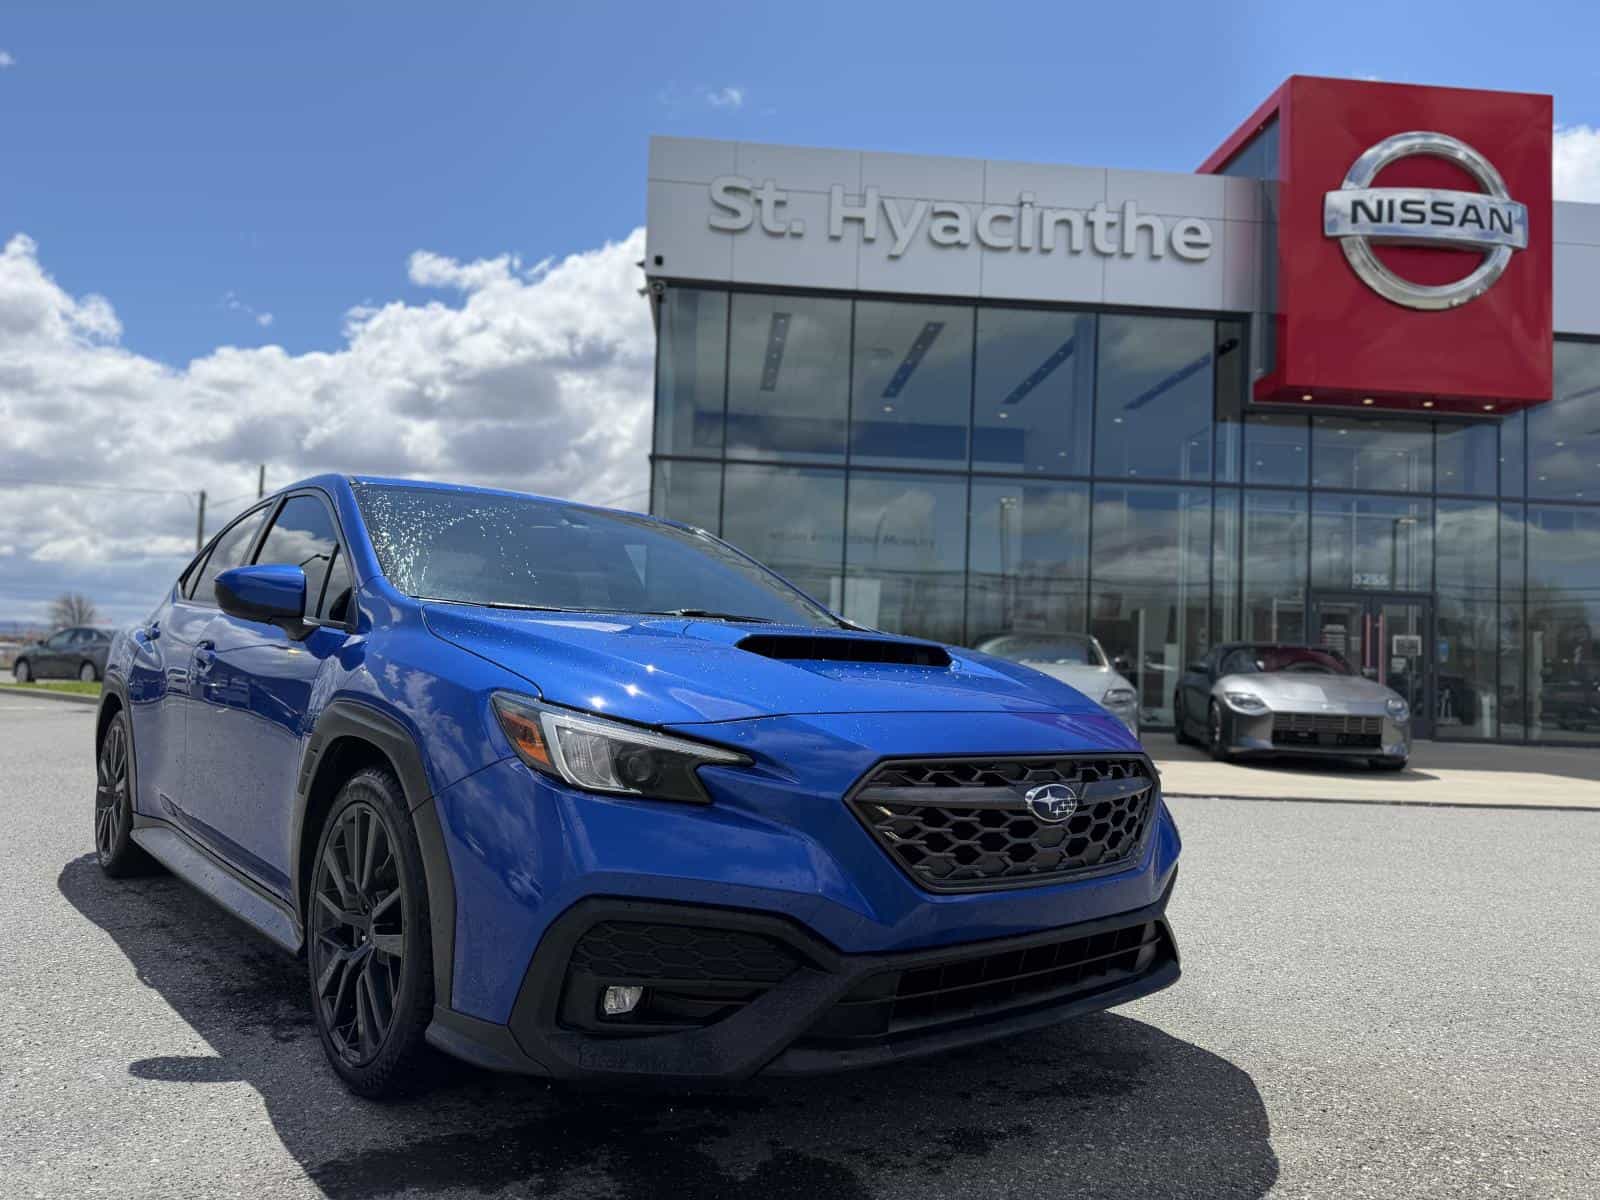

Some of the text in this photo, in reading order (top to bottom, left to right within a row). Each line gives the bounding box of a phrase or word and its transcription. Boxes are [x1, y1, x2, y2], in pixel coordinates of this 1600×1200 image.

[708, 176, 1213, 260] St. Hyacinthe
[1351, 199, 1514, 234] NISSAN
